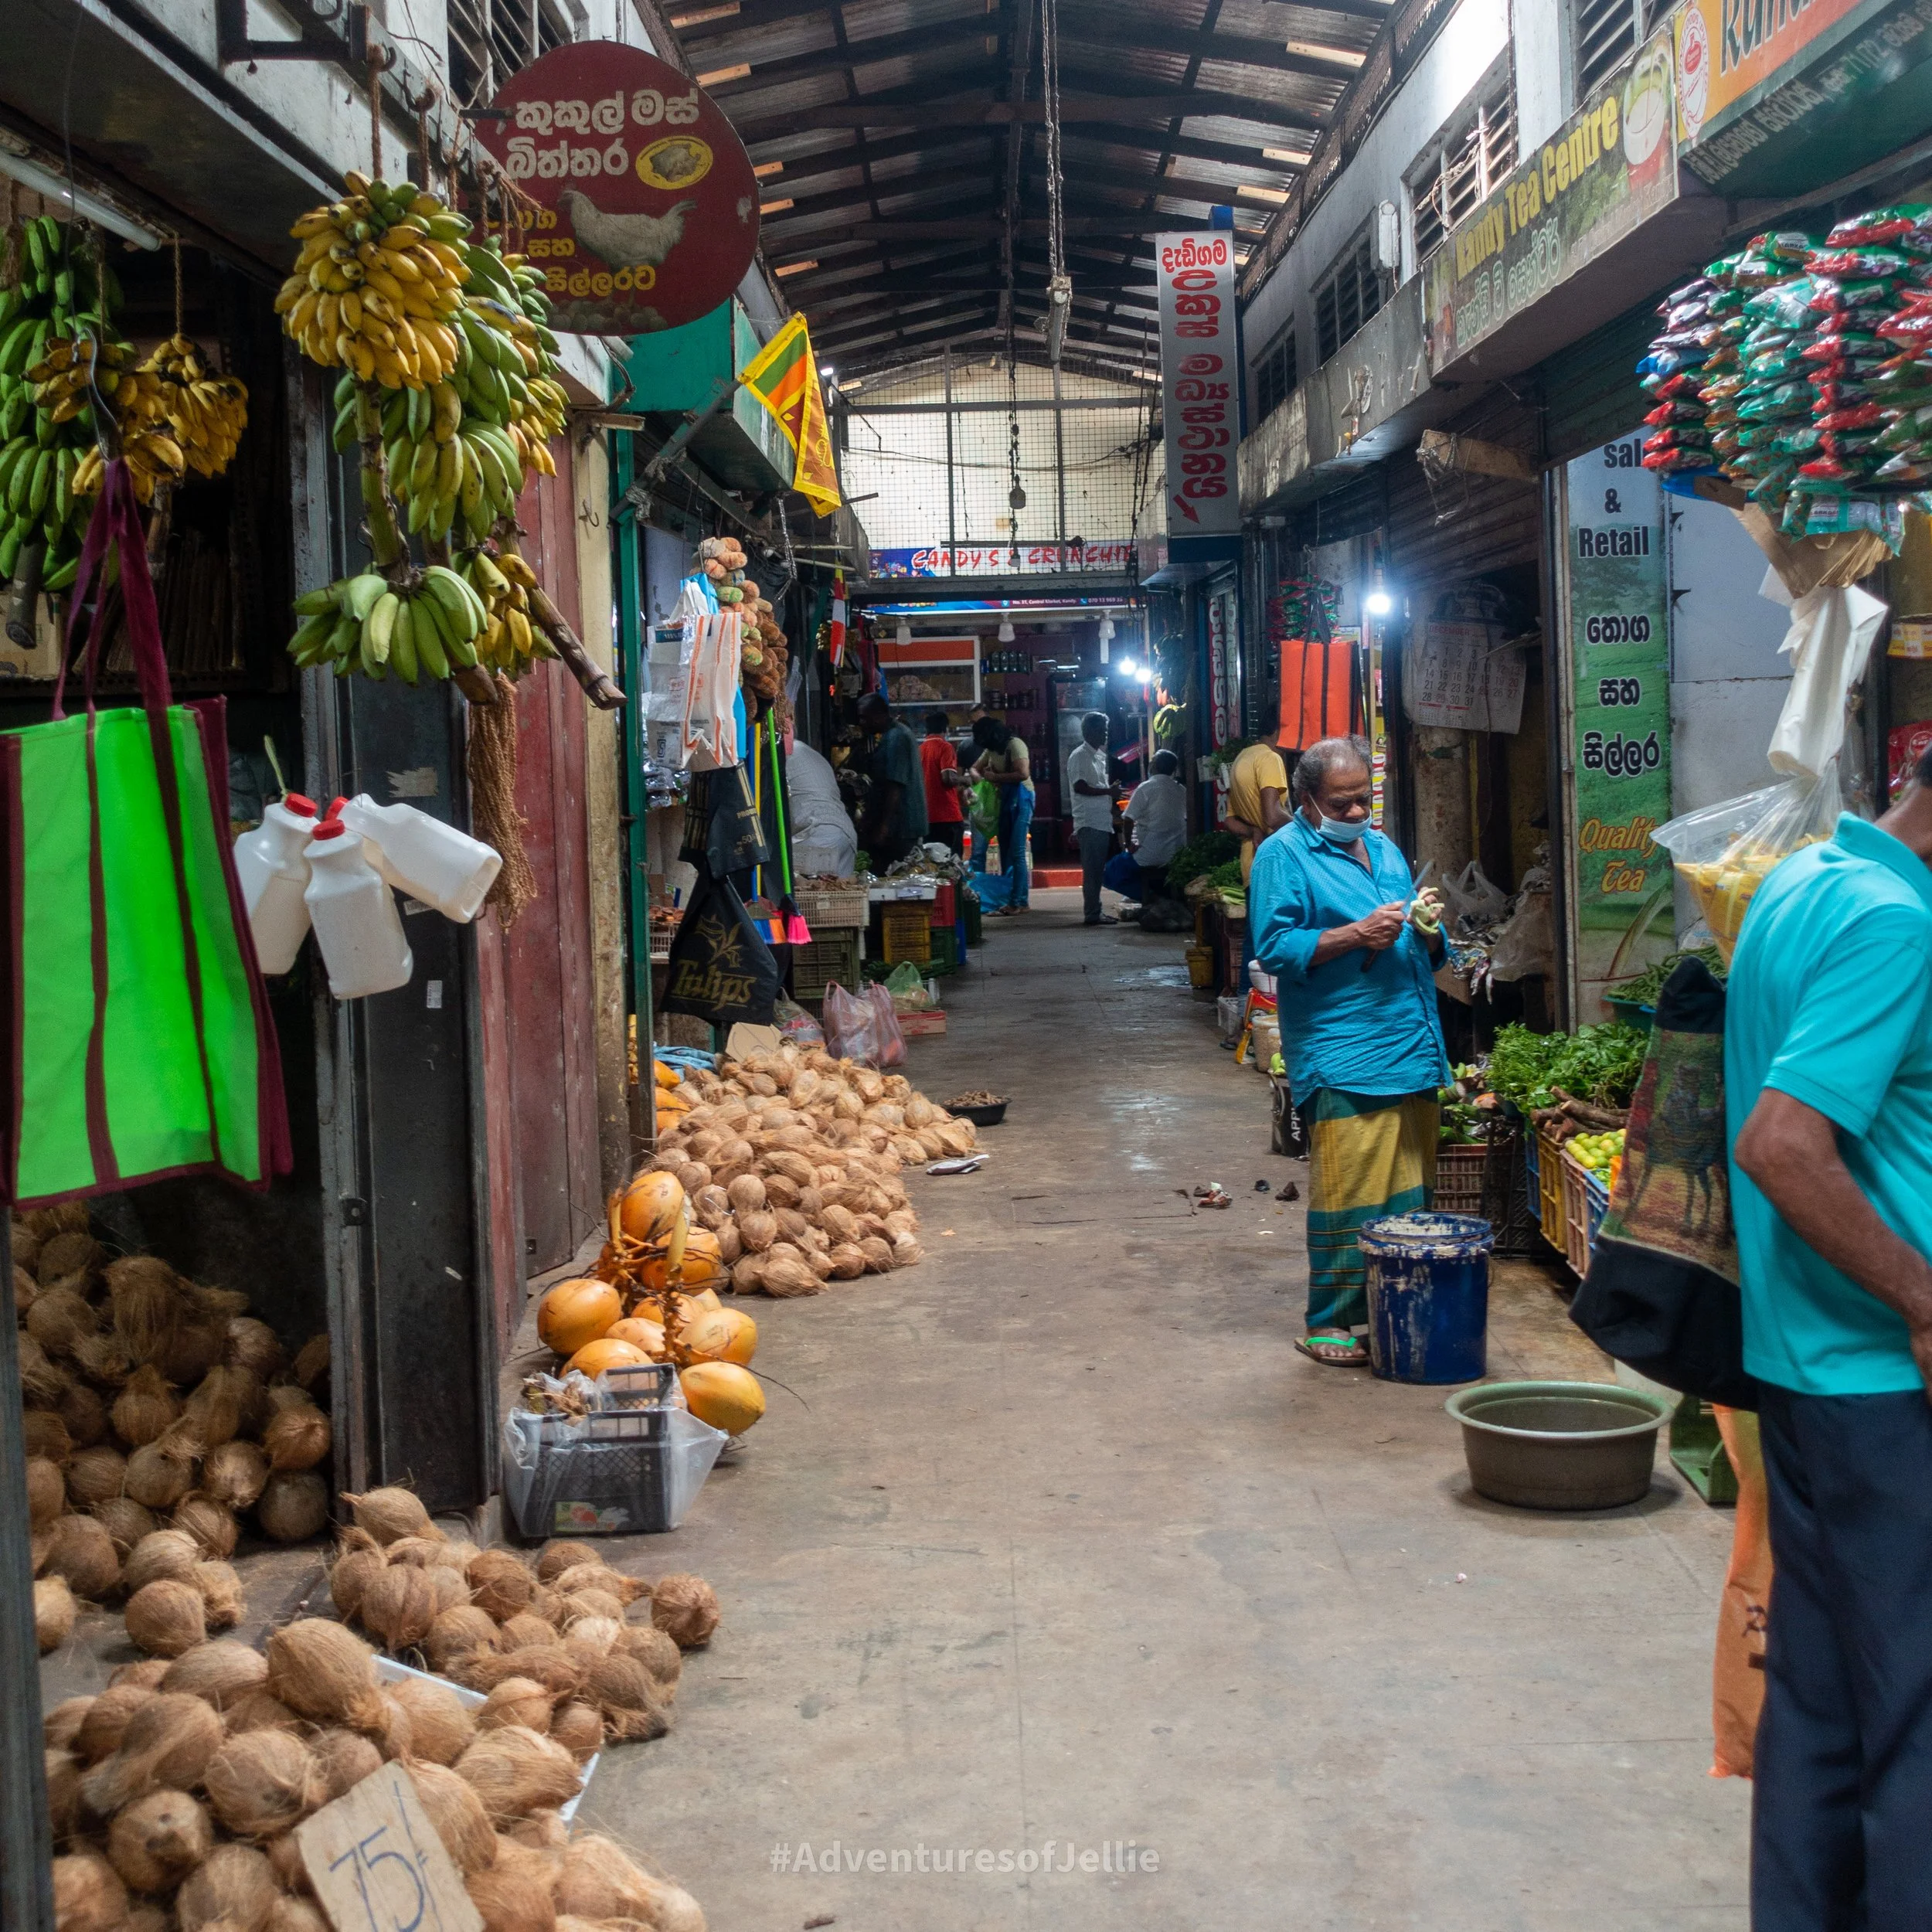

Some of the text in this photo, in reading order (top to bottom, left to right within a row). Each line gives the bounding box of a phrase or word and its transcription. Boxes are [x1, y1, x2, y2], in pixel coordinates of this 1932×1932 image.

[516, 88, 699, 135] කුකුල් මස්
[506, 136, 629, 179] බිත්තර
[1505, 170, 1540, 236] Tea
[1542, 96, 1619, 204] Centre
[527, 237, 575, 257] සහ
[545, 264, 656, 298] සිල්ලරට
[1604, 438, 1644, 468] sal
[1604, 488, 1621, 513] &
[1578, 526, 1650, 558] Retail
[1587, 615, 1651, 645] තොග
[1599, 678, 1640, 706] සහ
[1583, 731, 1660, 777] සිල්ලර
[1601, 860, 1645, 893] Tea
